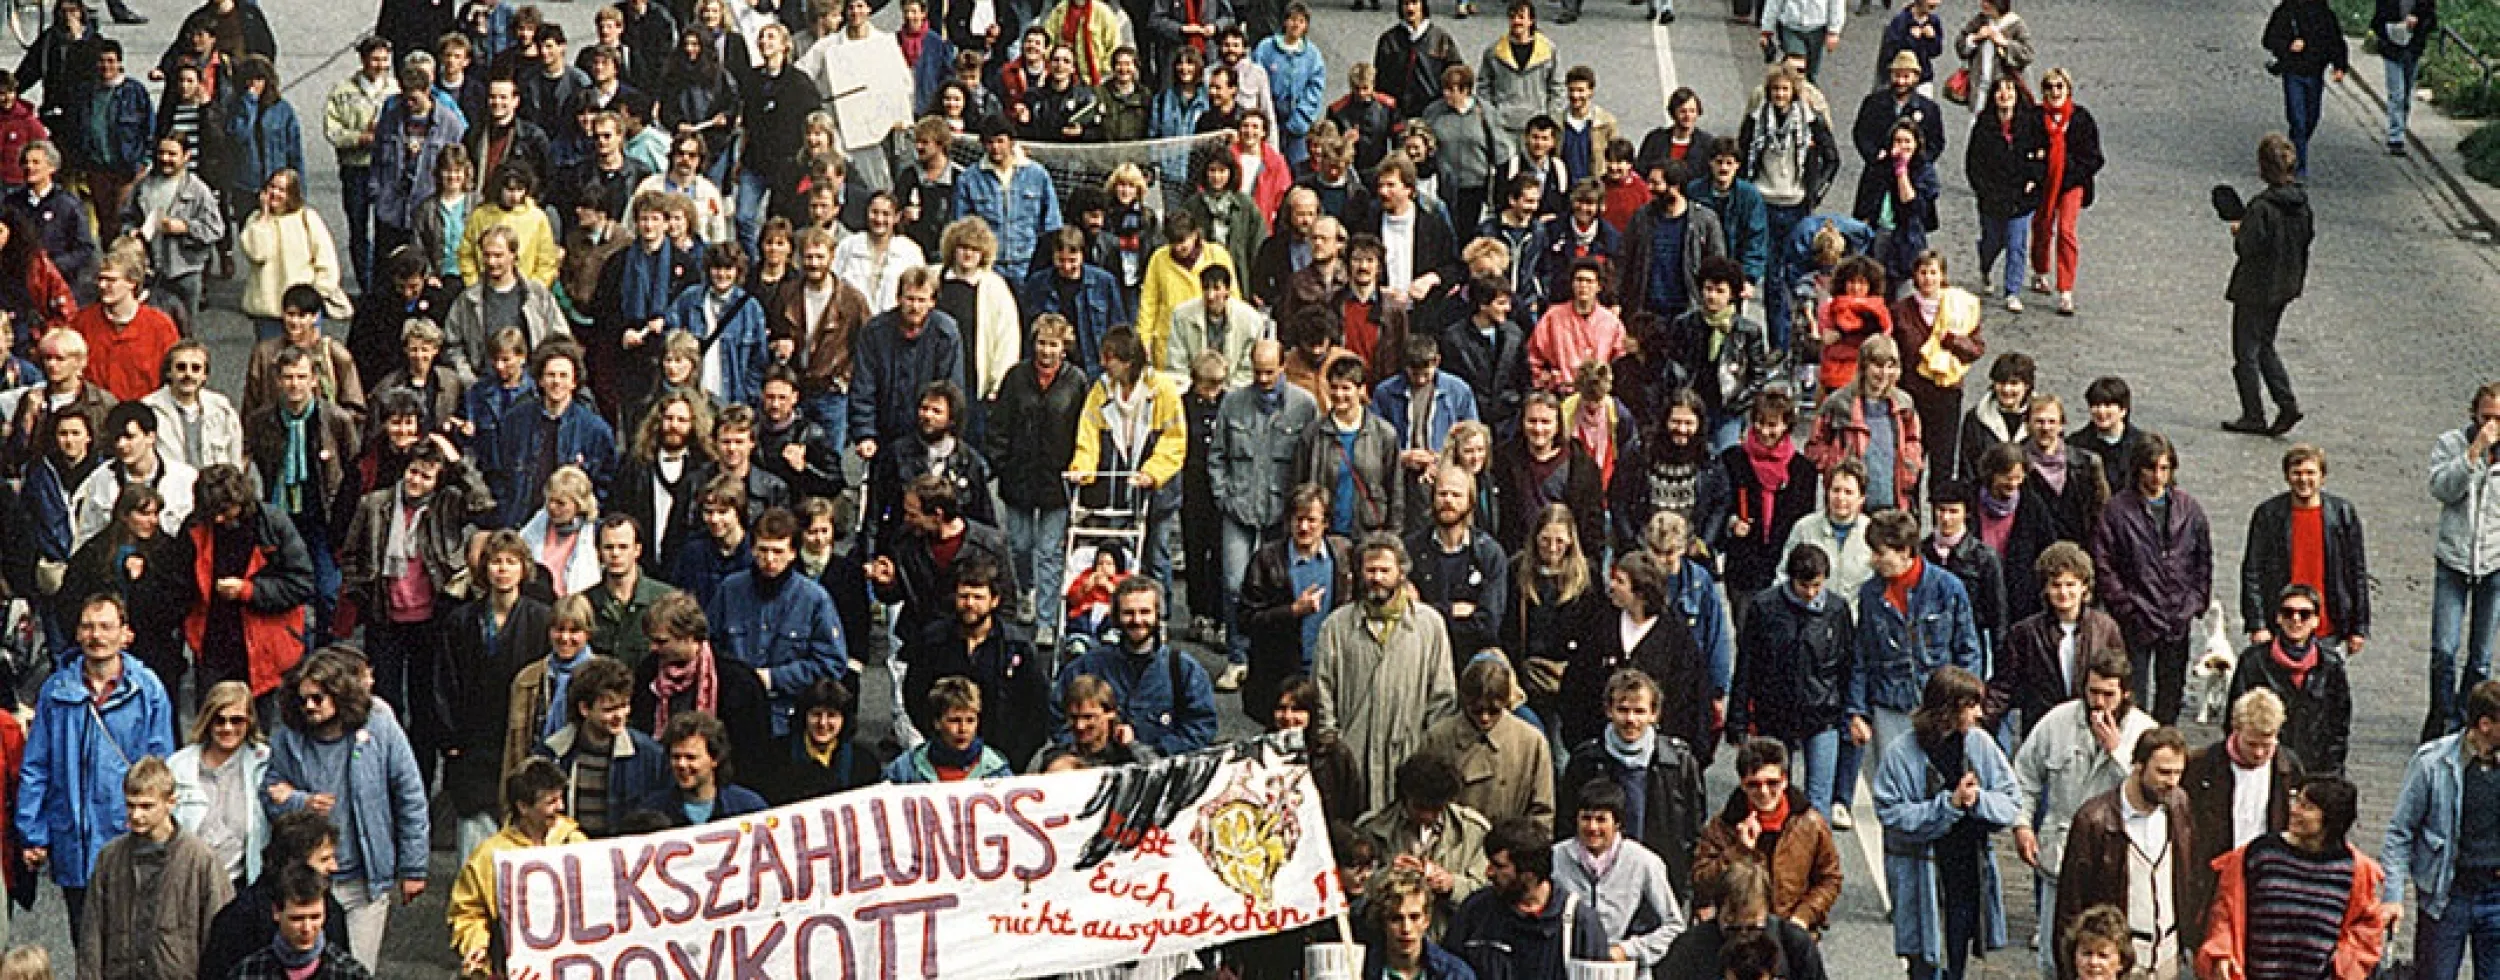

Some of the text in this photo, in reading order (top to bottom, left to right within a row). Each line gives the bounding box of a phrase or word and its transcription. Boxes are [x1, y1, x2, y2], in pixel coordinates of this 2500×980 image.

[1090, 861, 1174, 911] Euch
[552, 894, 958, 980] YKOTT
[988, 900, 1077, 936] nicht
